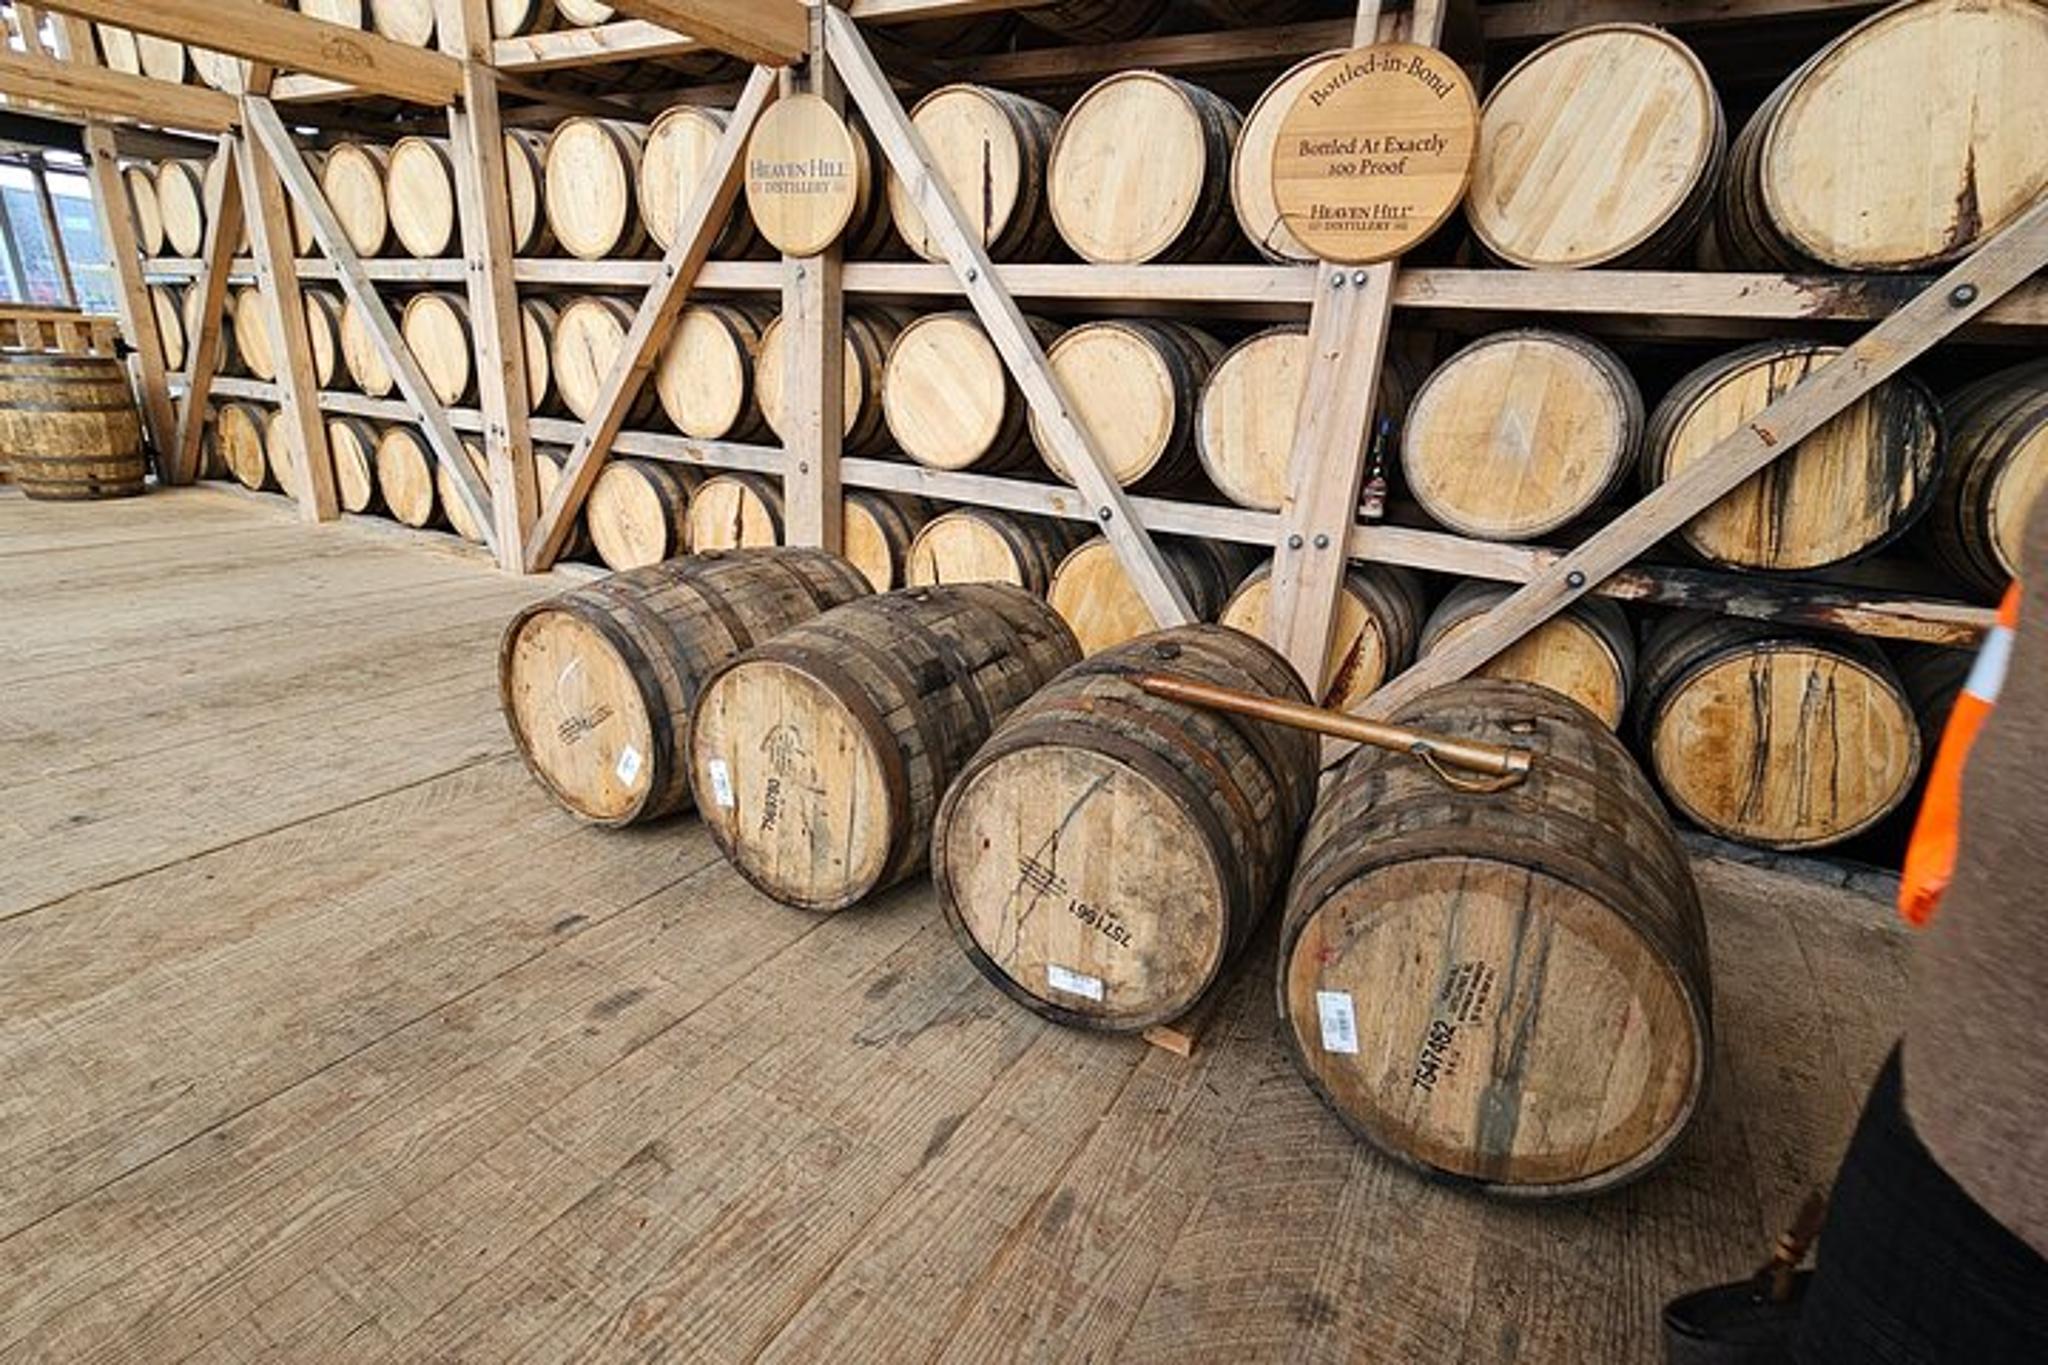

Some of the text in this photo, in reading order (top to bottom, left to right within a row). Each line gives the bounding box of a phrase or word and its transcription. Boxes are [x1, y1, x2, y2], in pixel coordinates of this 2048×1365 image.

[1309, 53, 1455, 107] Bottled-in-Bond
[1299, 134, 1448, 157] Bottled At Exactly
[750, 158, 844, 179] HEAVEN HILL
[1328, 157, 1408, 176] 100 Proof
[764, 181, 831, 194] DISTILLERY
[1310, 204, 1370, 219] HEAVEN
[1324, 221, 1391, 231] DISTILLERY
